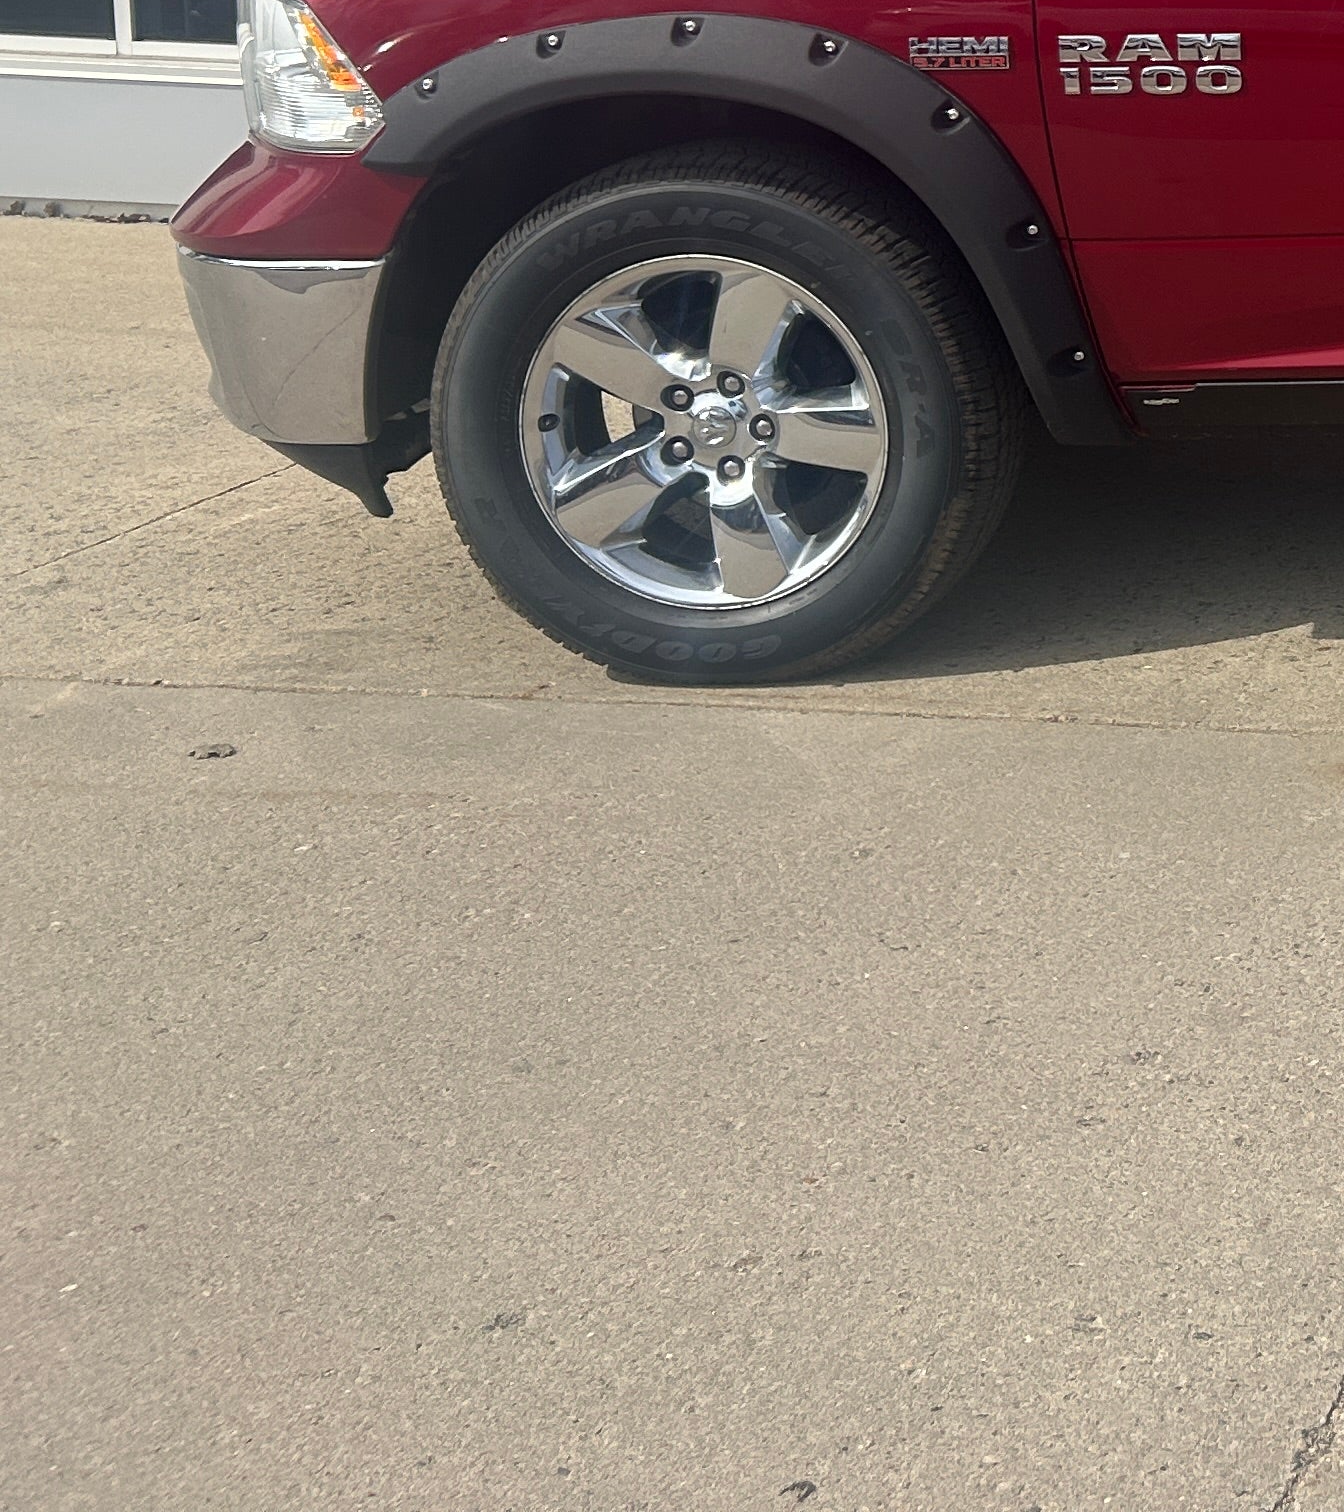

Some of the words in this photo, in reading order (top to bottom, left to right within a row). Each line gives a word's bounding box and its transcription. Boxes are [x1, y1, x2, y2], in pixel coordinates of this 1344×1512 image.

[908, 36, 1009, 55] HEMI
[1058, 33, 1242, 63] RAM
[912, 56, 946, 68] 5.7
[948, 56, 1006, 68] LITER
[1059, 65, 1243, 96] 1500
